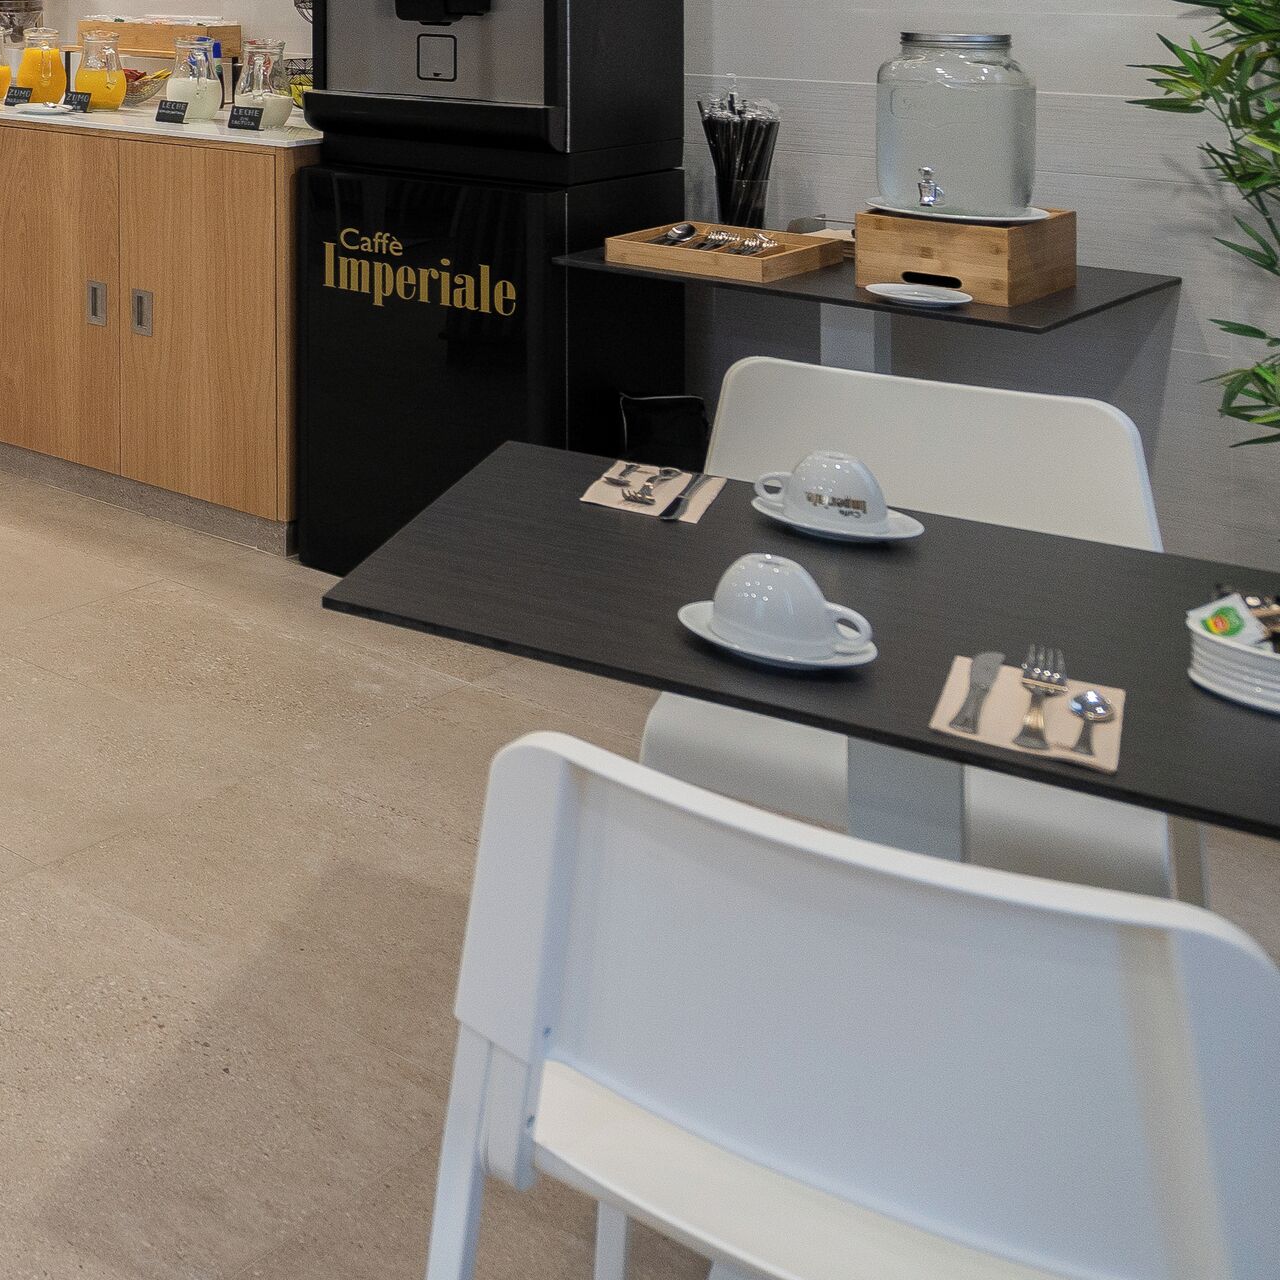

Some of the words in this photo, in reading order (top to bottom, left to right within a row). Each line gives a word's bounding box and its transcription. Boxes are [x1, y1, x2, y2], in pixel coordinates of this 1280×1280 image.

[8, 88, 31, 97] ZUMO
[66, 93, 89, 102] ZUMO
[161, 101, 186, 110] LECHE
[233, 108, 260, 117] LECHE
[340, 227, 403, 256] Caffè
[322, 241, 517, 316] Imperiale
